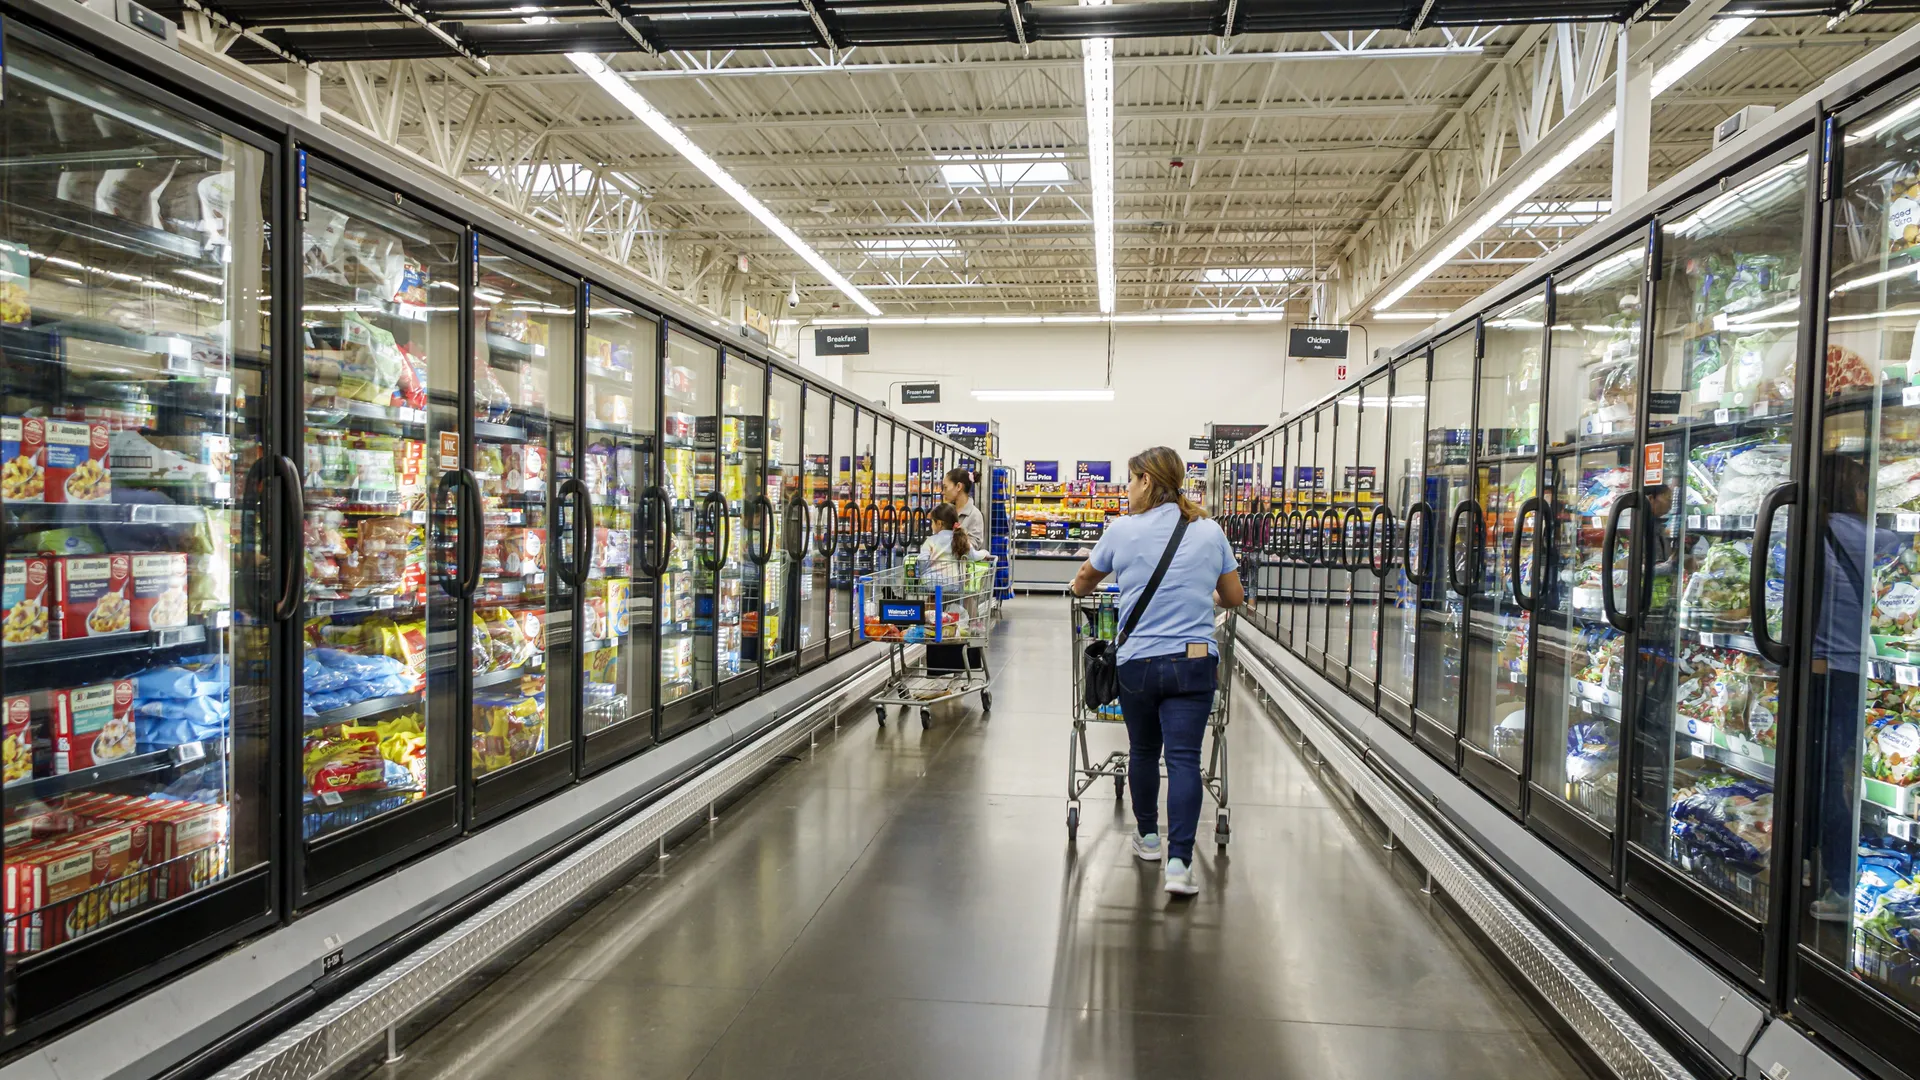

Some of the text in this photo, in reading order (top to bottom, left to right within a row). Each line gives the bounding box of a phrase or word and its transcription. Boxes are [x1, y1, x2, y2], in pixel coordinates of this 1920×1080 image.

[1894, 217, 1912, 227] Okra
[826, 335, 857, 343] Breakfast
[1306, 336, 1331, 345] Chicken
[960, 426, 977, 434] Price
[443, 440, 456, 451] WIC
[1648, 452, 1661, 463] WIC
